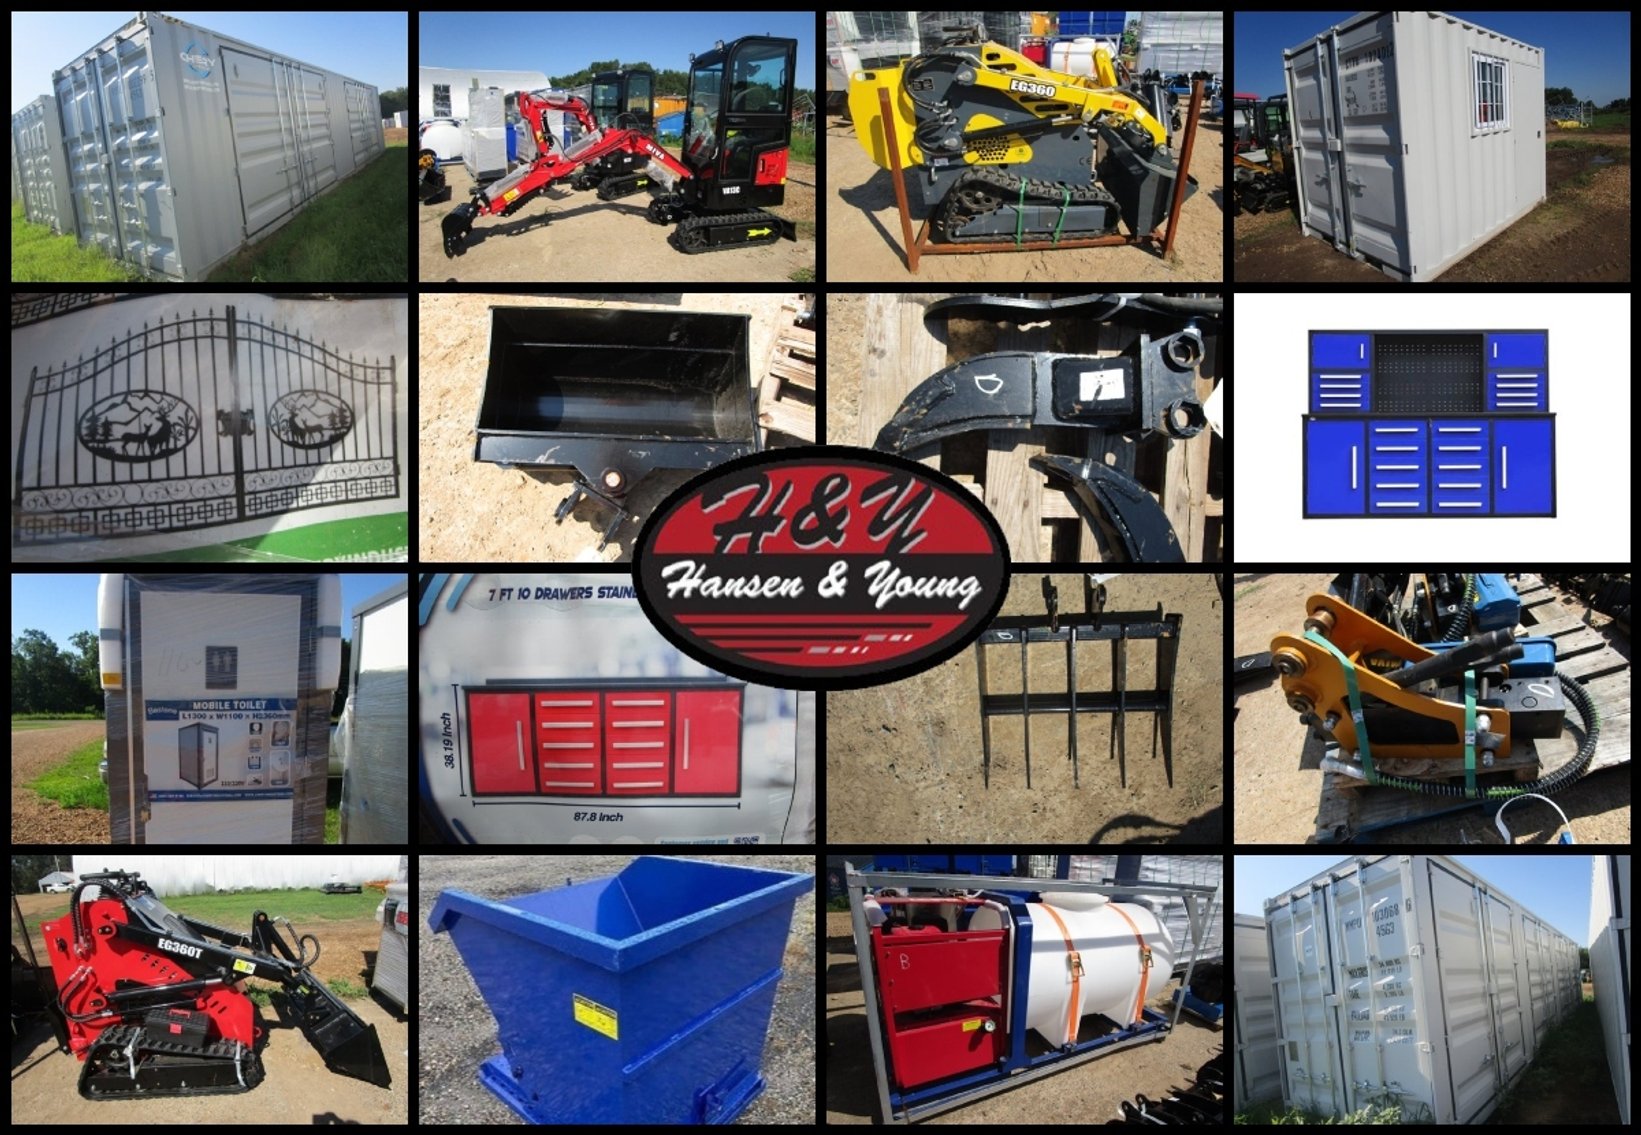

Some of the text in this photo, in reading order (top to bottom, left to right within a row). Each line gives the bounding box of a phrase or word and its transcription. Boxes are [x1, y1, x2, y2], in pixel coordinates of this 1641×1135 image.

[1010, 79, 1056, 98] EG360
[645, 143, 665, 160] MIVA
[488, 589, 496, 601] 7
[500, 587, 514, 601] FT
[517, 586, 532, 600] 10
[535, 586, 594, 600] DRAWERS
[192, 700, 267, 710] MOBILE TOILET
[182, 712, 207, 720] L1300
[216, 712, 243, 720] W1100
[440, 712, 455, 769] 38.19 Inch
[573, 811, 624, 822] 87.8 Inch
[158, 938, 203, 959] EG360T
[900, 953, 910, 970] B
